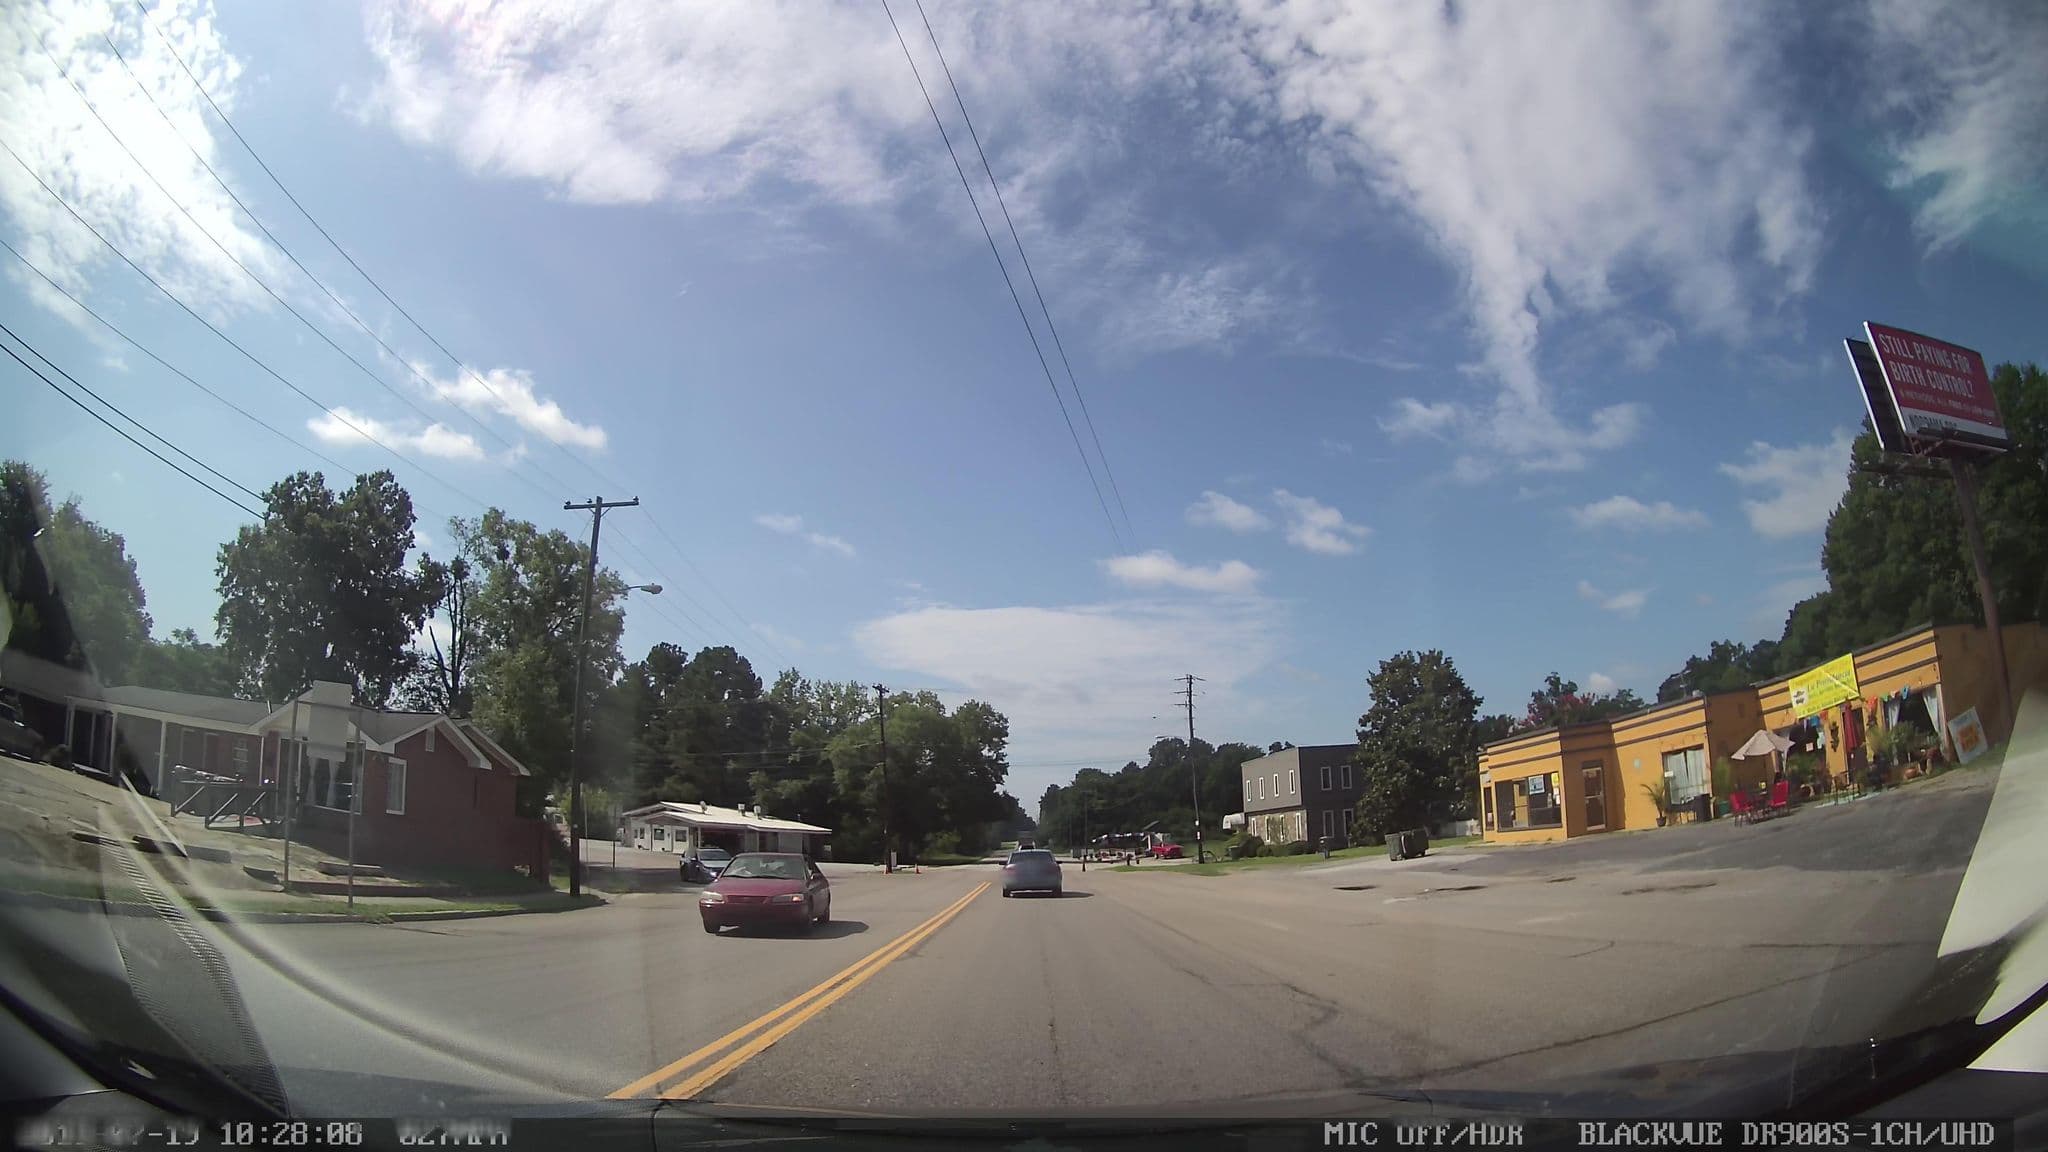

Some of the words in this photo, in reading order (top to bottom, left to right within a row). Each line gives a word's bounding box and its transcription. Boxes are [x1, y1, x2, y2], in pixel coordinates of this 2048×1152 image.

[1879, 333, 1914, 359] STILL
[1913, 341, 1953, 369] PAYING
[1951, 352, 1973, 375] FOR
[1889, 360, 1927, 387] BIRTH
[1926, 369, 1975, 399] CONTROL?
